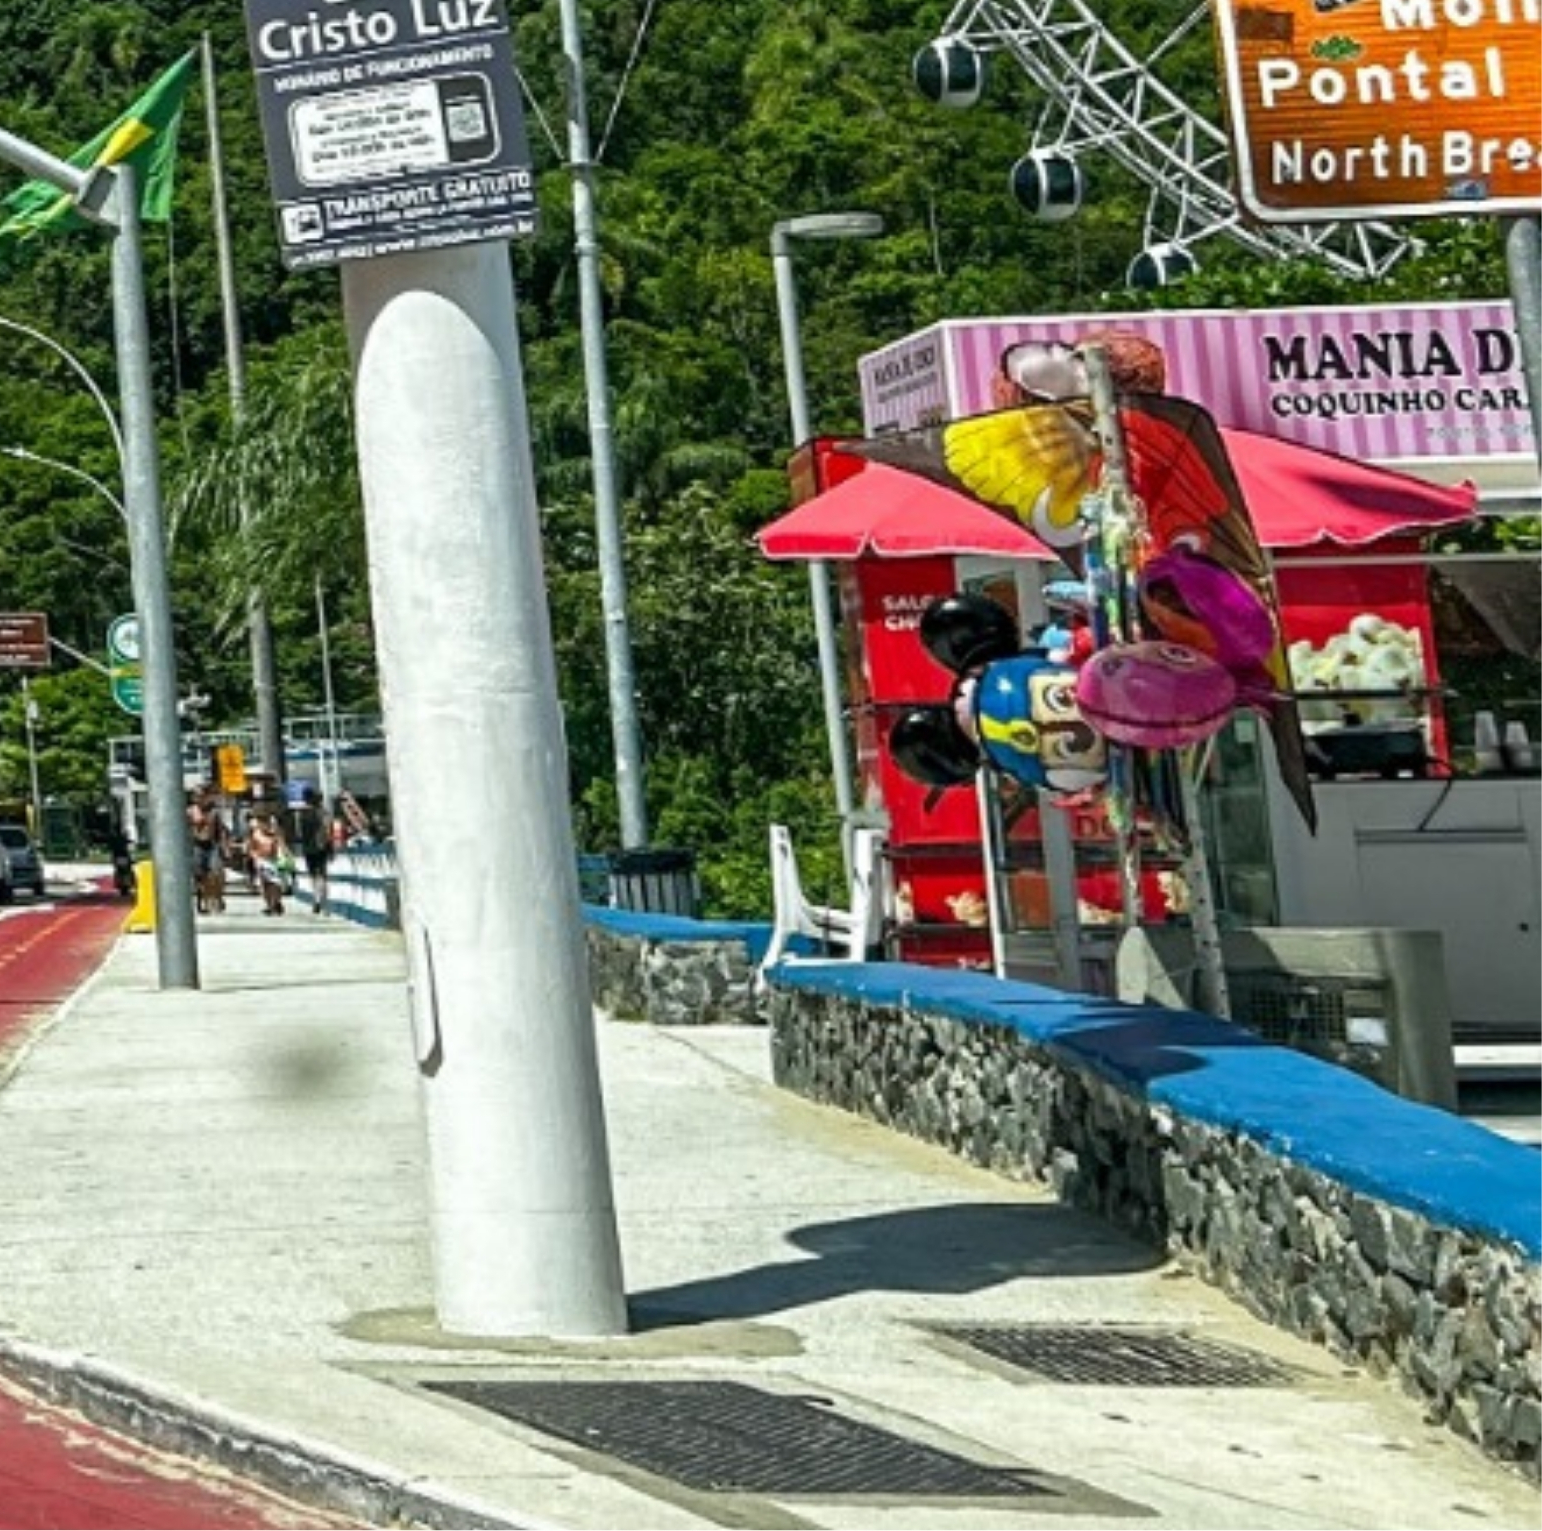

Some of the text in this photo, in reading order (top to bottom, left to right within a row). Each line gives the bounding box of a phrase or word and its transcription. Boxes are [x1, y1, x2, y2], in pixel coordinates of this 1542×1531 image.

[258, 11, 397, 59] Cristo
[1256, 47, 1506, 108] Pontal
[1272, 130, 1542, 185] North Bre
[323, 186, 439, 218] TRANSPORTE
[444, 171, 531, 199] GRATUITO
[1264, 329, 1525, 382] MANIA D
[1272, 388, 1532, 421] COQUINHO CAR
